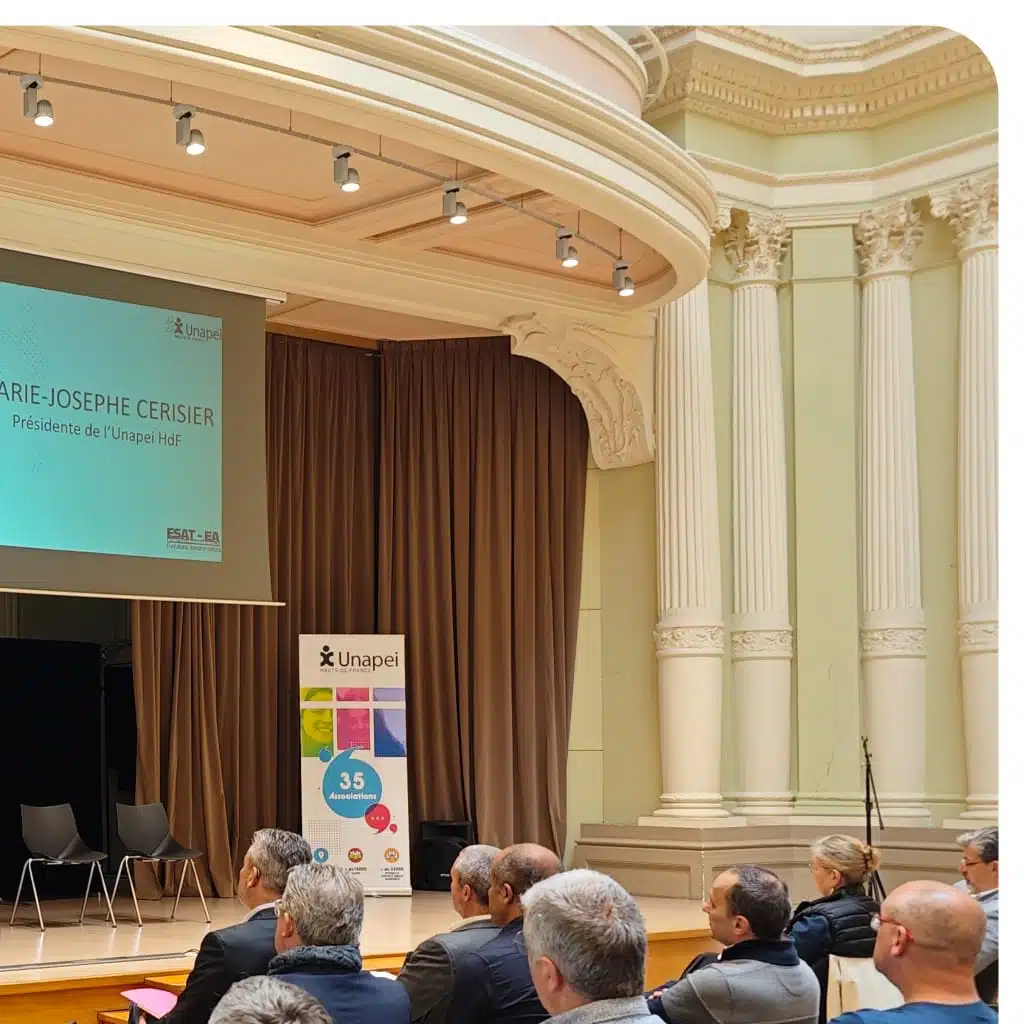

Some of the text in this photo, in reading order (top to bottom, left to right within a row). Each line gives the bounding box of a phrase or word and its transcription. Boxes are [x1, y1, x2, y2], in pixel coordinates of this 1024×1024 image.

[185, 323, 222, 342] Unapei
[136, 399, 215, 428] CERISIER
[12, 414, 81, 436] Présidente
[84, 423, 101, 438] de
[158, 433, 182, 448] HdF
[166, 527, 196, 541] ESAT
[204, 530, 220, 545] EA
[338, 651, 399, 671] Unapei
[339, 771, 365, 790] 35
[328, 791, 377, 800] Associations
